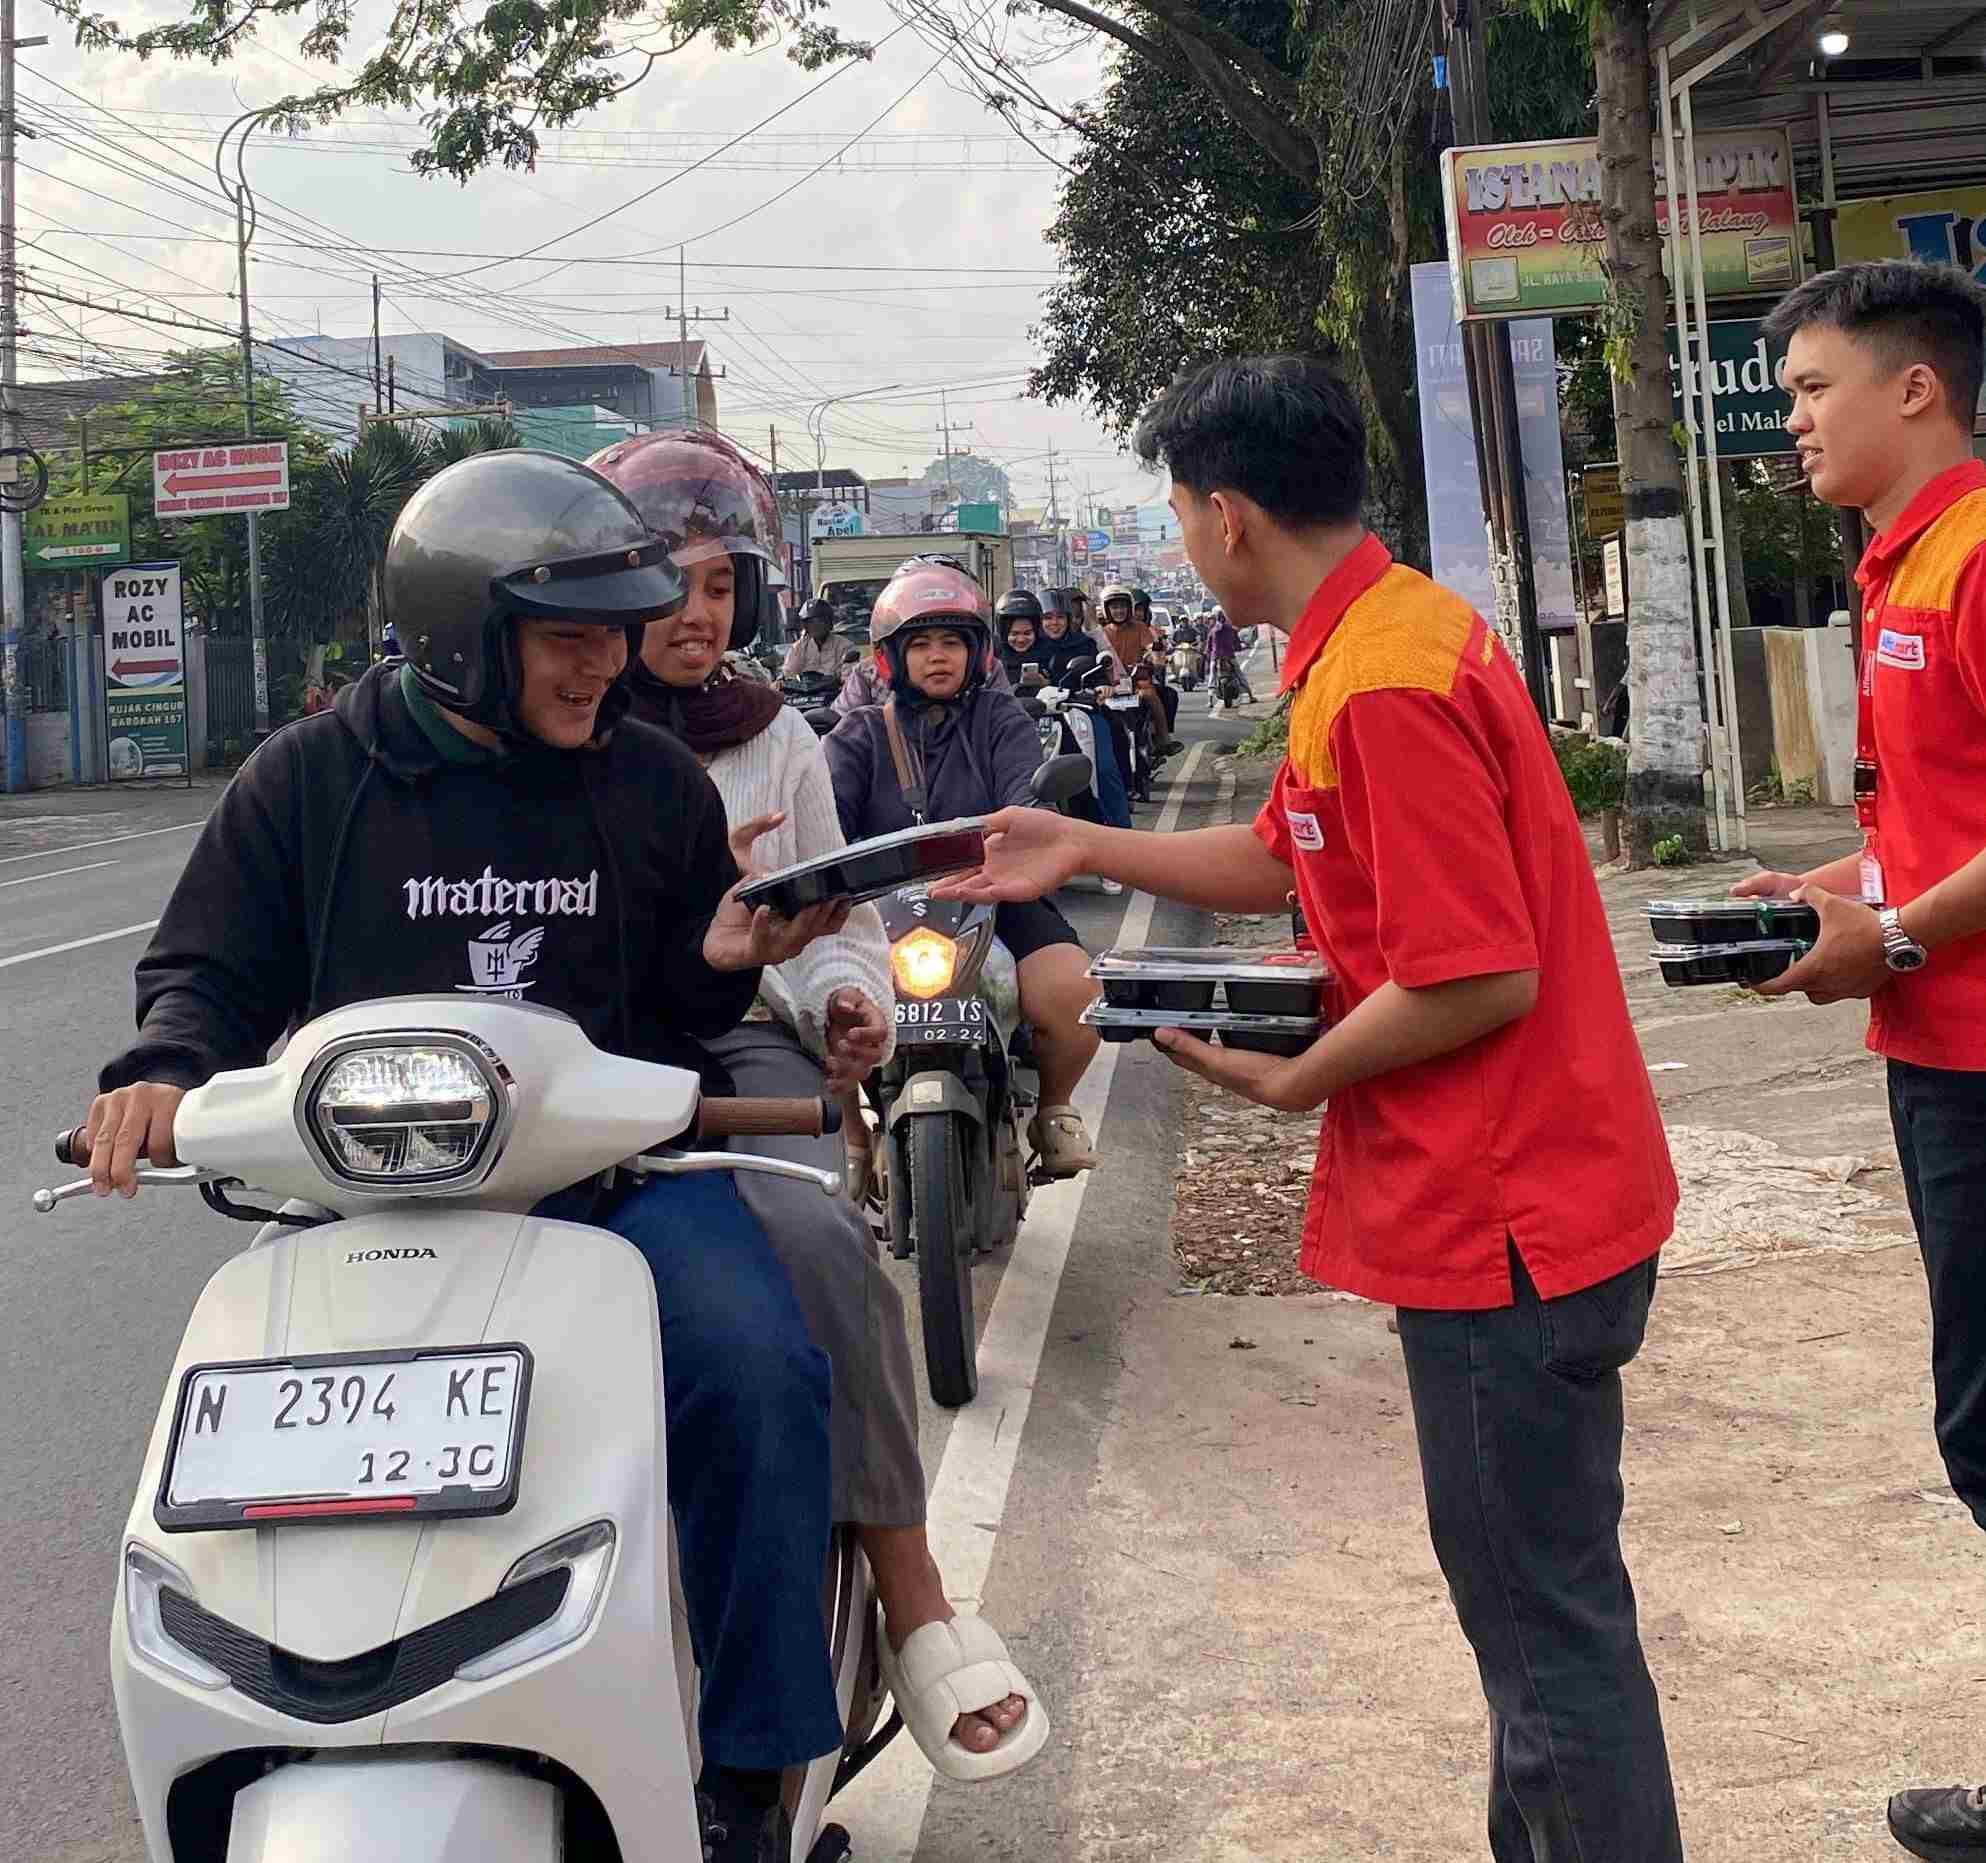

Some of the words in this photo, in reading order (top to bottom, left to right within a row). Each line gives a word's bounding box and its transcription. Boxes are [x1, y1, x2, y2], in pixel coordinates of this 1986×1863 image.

[1466, 160, 1601, 211] ISTANA
[1488, 221, 1537, 249] Oleh
[114, 578, 168, 598] ROZY
[127, 605, 154, 623] AC
[112, 629, 175, 649] MOBIL
[403, 865, 599, 920] maternal
[894, 1002, 943, 1023] 6812
[957, 1000, 982, 1022] YS
[344, 1247, 439, 1264] HONDA
[194, 1383, 228, 1434] N
[273, 1373, 397, 1430] 2394
[446, 1366, 507, 1417] KE
